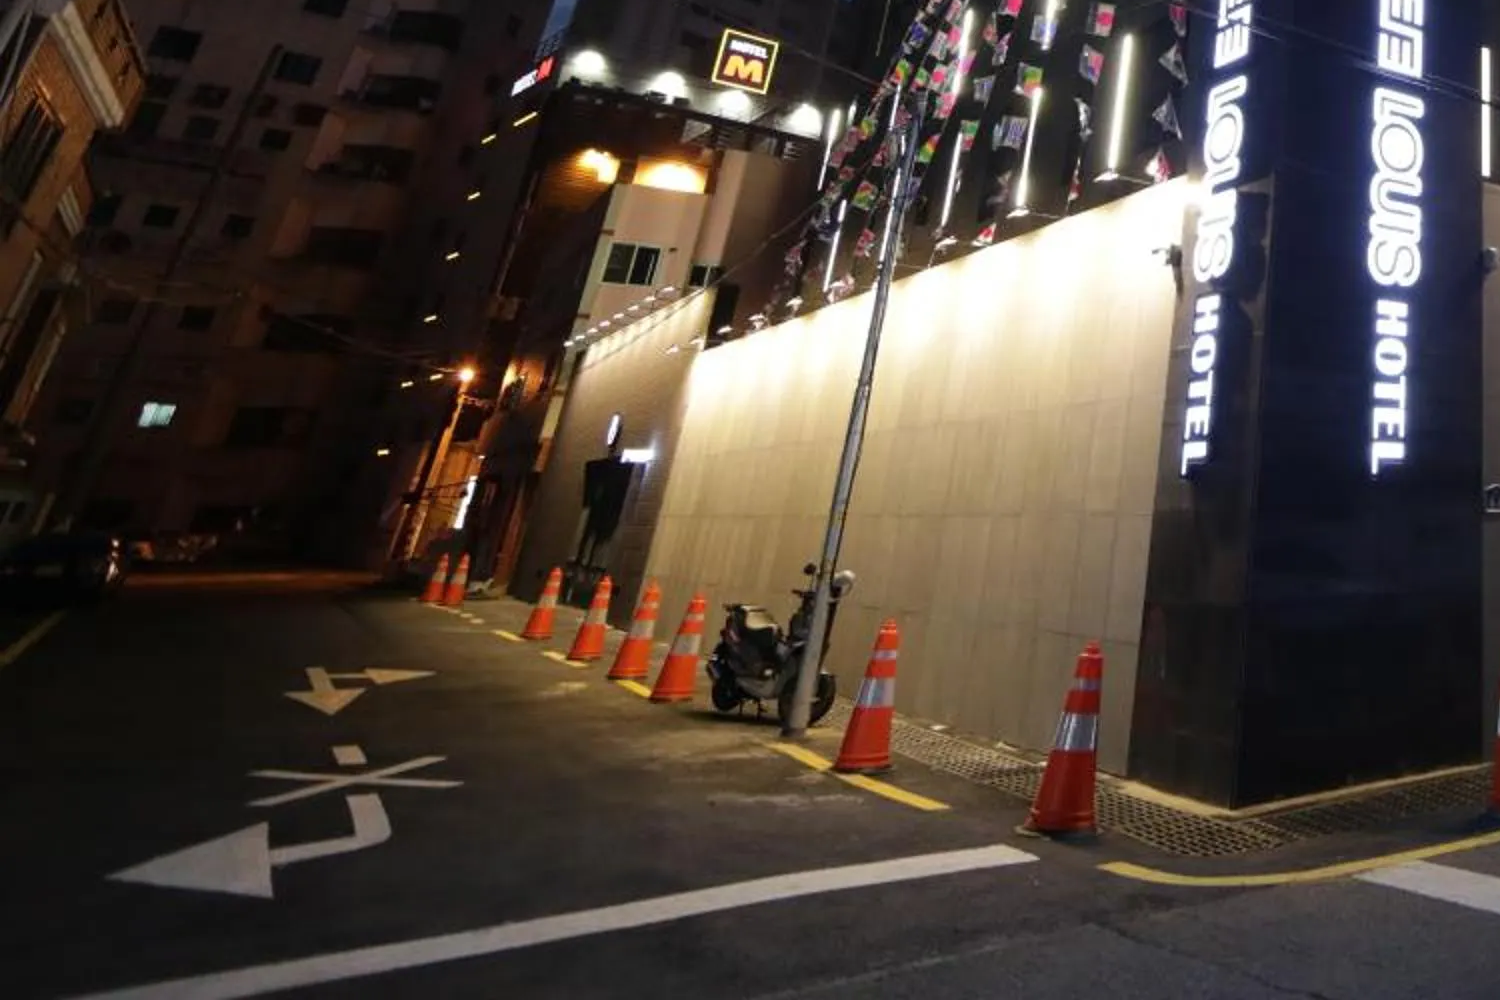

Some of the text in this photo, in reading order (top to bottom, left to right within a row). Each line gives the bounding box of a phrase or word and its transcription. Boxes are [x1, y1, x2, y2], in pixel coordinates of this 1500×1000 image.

[723, 55, 764, 83] M
[1193, 75, 1248, 284] LOUIS
[1368, 87, 1425, 288] LOUIS
[1181, 295, 1221, 476] HOTEL
[1371, 298, 1409, 475] HOTEL
